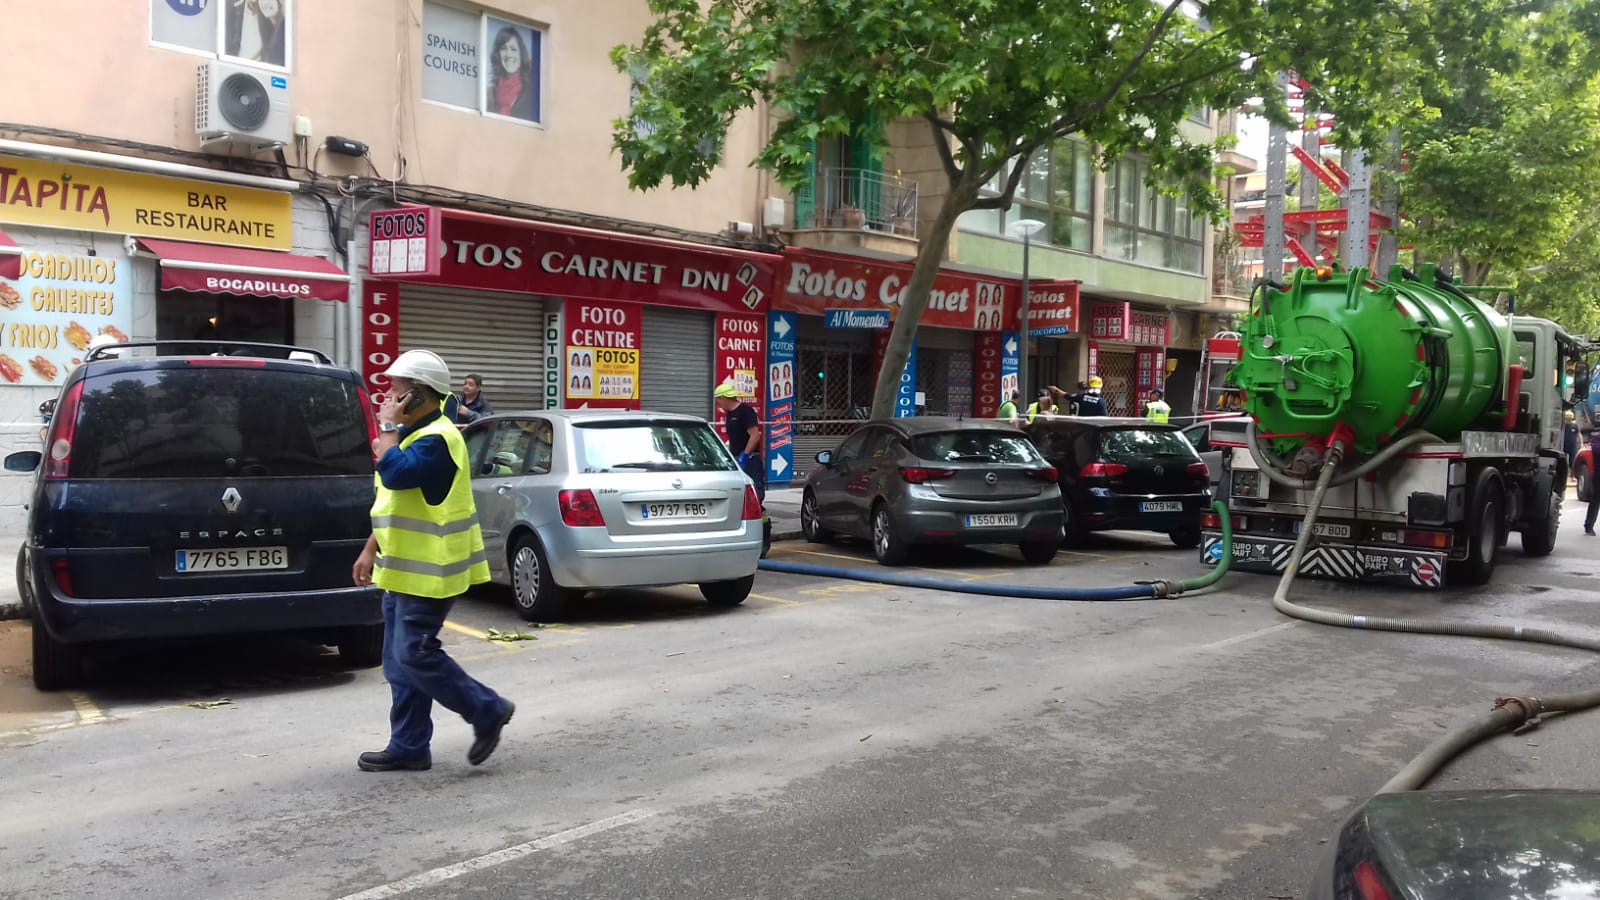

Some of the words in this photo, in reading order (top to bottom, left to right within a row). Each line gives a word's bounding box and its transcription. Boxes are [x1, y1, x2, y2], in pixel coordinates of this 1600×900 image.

[426, 33, 476, 57] SPANISH
[423, 54, 479, 79] COURSES
[187, 192, 227, 211] BAR
[136, 209, 275, 238] RESTAURANTE
[374, 213, 426, 238] FOTOS
[440, 240, 523, 270] TOS
[541, 252, 667, 285] CARNET
[681, 268, 730, 292] DNI
[206, 277, 310, 294] BOCADILLOS
[786, 262, 867, 301] Fotos
[30, 286, 114, 316] CALIENTES
[1027, 290, 1065, 304] Fotos
[581, 306, 626, 326] FOTO
[830, 312, 844, 327] Al
[845, 314, 885, 327] Momento
[1132, 312, 1170, 328] CARNET
[722, 319, 758, 334] FOTOS
[9, 323, 58, 350] FRIOS
[571, 329, 635, 348] CENTRE
[718, 337, 762, 352] CARNET
[770, 341, 794, 350] FOTOS
[546, 314, 559, 410] FOTOCOP
[596, 350, 636, 364] FOTOS
[726, 356, 756, 370] D.N.I.
[981, 337, 995, 415] FOTOCOP
[650, 504, 680, 516] 9737
[685, 504, 706, 516] FBG
[971, 515, 995, 525] 1550
[997, 514, 1015, 525] KRH
[179, 528, 283, 538] ESPACE
[190, 551, 239, 568] 7765
[246, 550, 282, 566] FBG
[1365, 554, 1389, 564] EURO
[1365, 562, 1388, 570] PART
